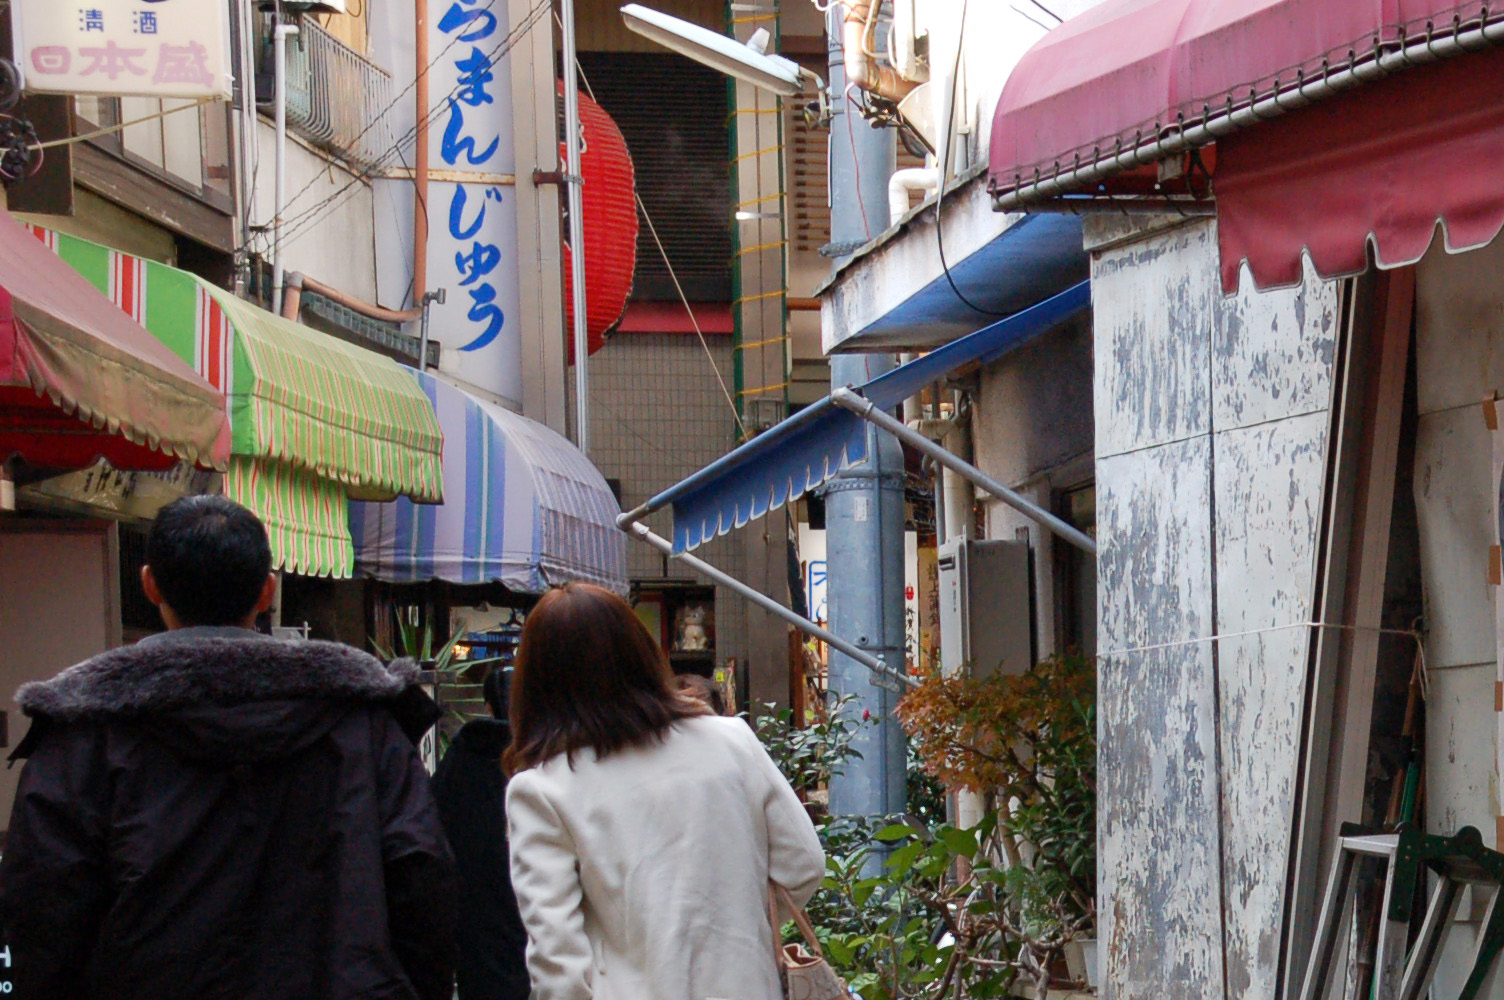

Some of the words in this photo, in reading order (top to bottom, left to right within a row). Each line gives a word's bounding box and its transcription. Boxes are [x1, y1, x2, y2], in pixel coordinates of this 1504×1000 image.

[78, 8, 158, 34] 清酒
[31, 40, 215, 88] 日本盛
